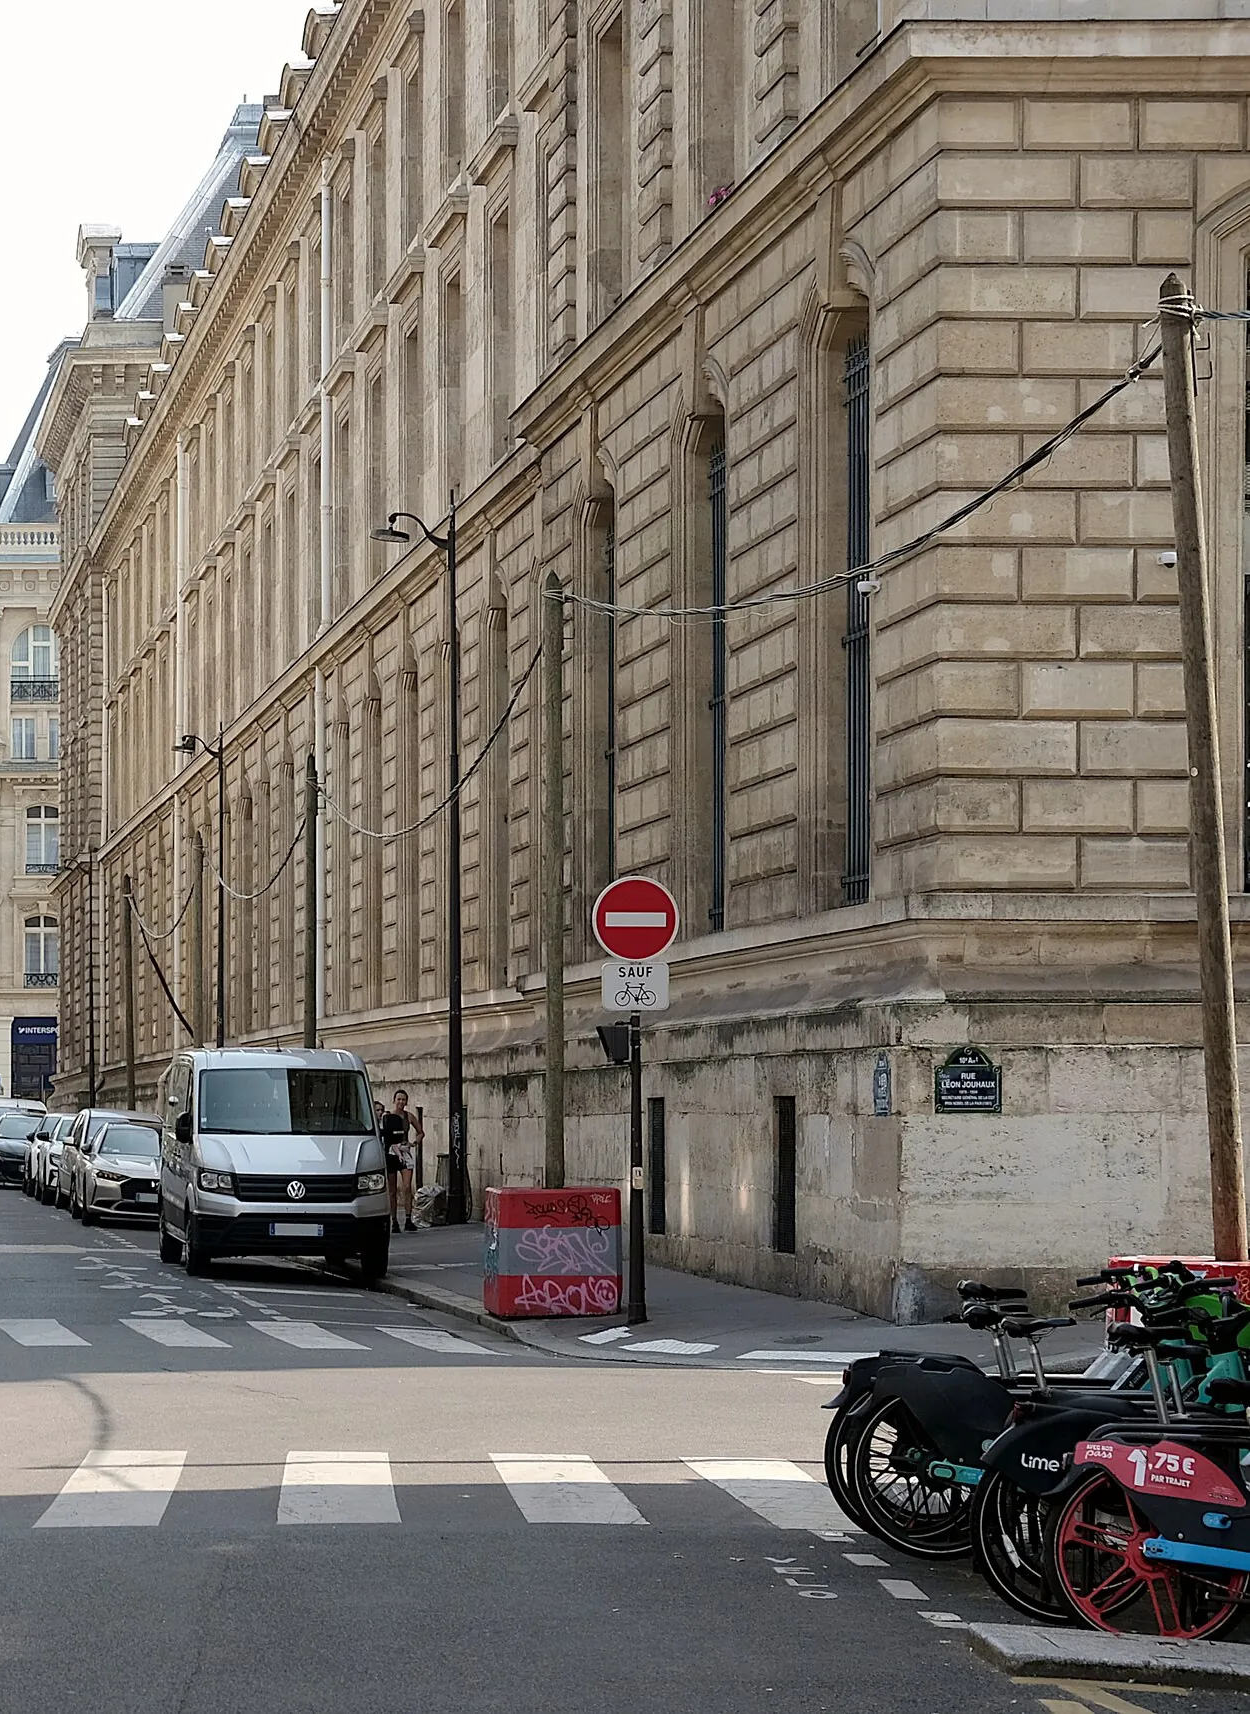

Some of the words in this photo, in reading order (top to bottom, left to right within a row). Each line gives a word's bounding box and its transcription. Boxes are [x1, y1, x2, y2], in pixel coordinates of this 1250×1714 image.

[618, 966, 653, 978] SAUF
[960, 1072, 976, 1080] RUE
[1086, 1443, 1101, 1451] AVEC
[1084, 1450, 1113, 1460] pass
[1020, 1452, 1061, 1472] Lime
[1151, 1473, 1165, 1483] PAR
[1165, 1477, 1191, 1488] TRAJET
